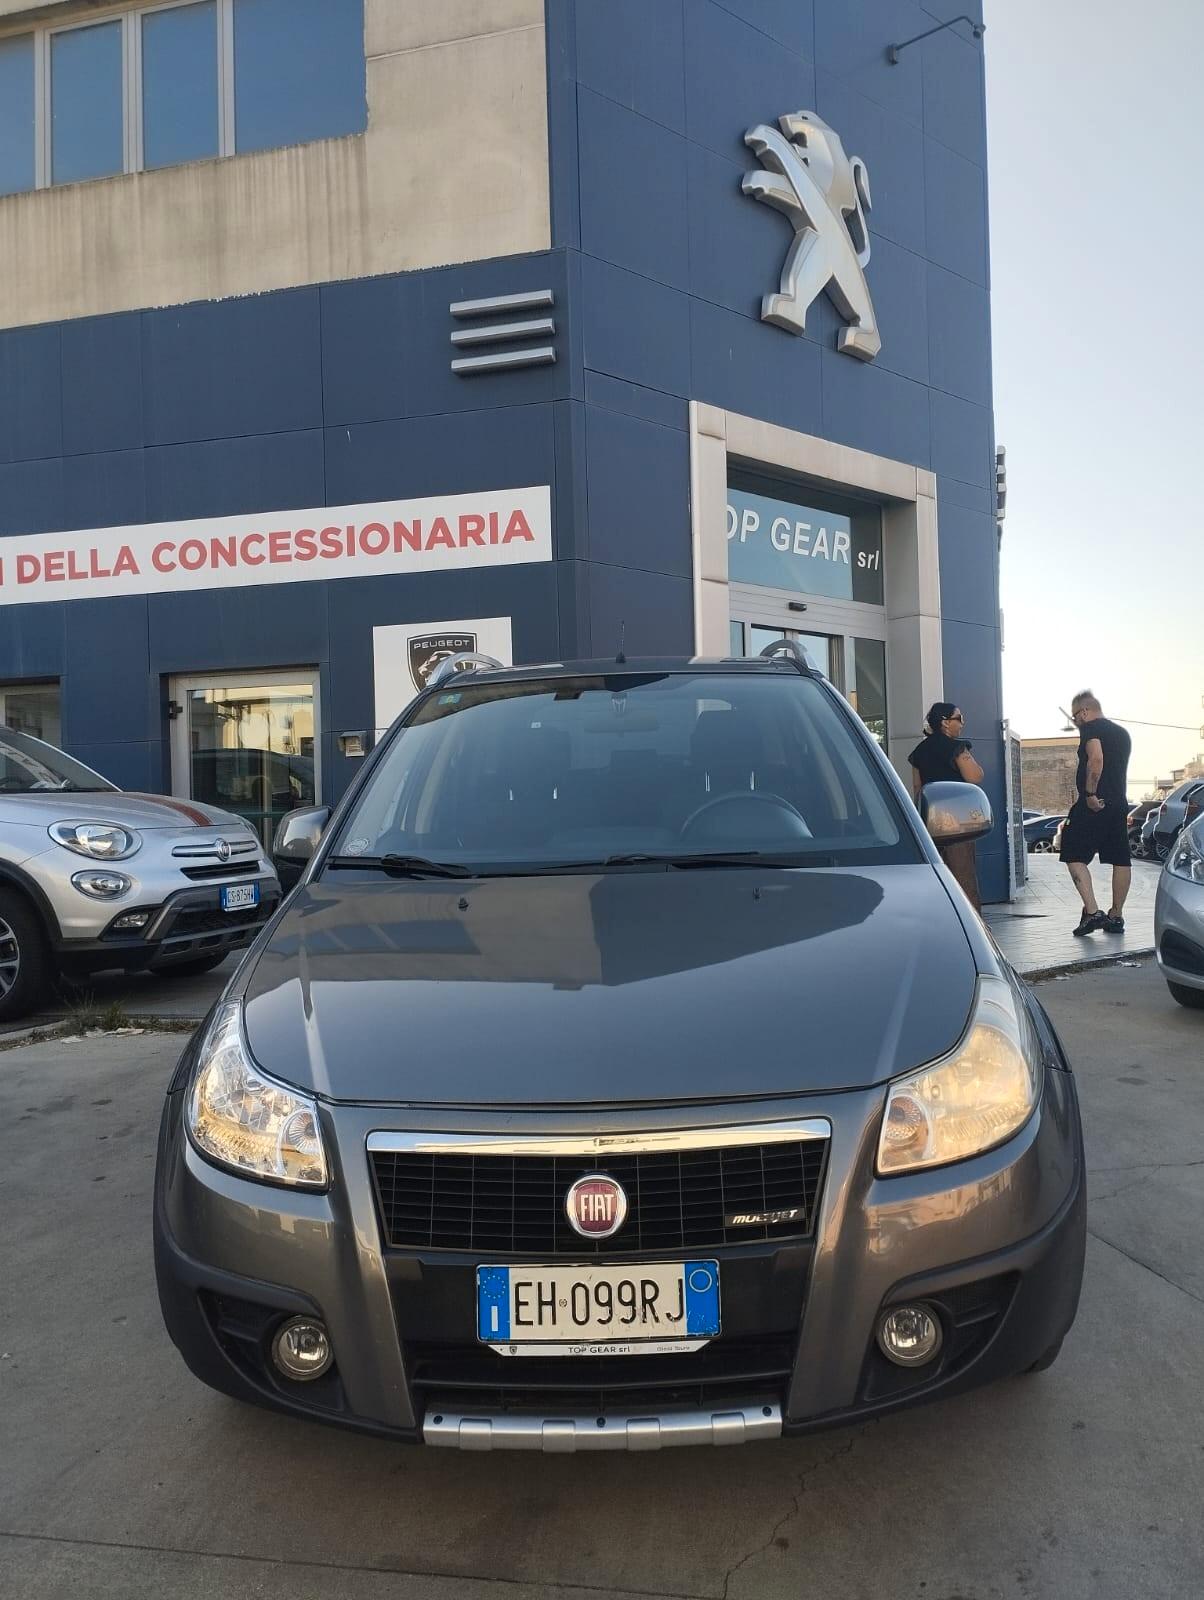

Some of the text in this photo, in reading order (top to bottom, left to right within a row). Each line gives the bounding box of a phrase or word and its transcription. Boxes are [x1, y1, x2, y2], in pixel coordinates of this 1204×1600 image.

[16, 545, 140, 585] DELLA
[151, 509, 535, 573] CONCESSIONARIA
[727, 504, 880, 571] OP GEAR srl
[413, 639, 470, 649] PEUGEOT
[580, 1193, 614, 1222] FIAT
[514, 1278, 684, 1326] EH 099RJ
[568, 1345, 631, 1354] TOP GEAR srl
